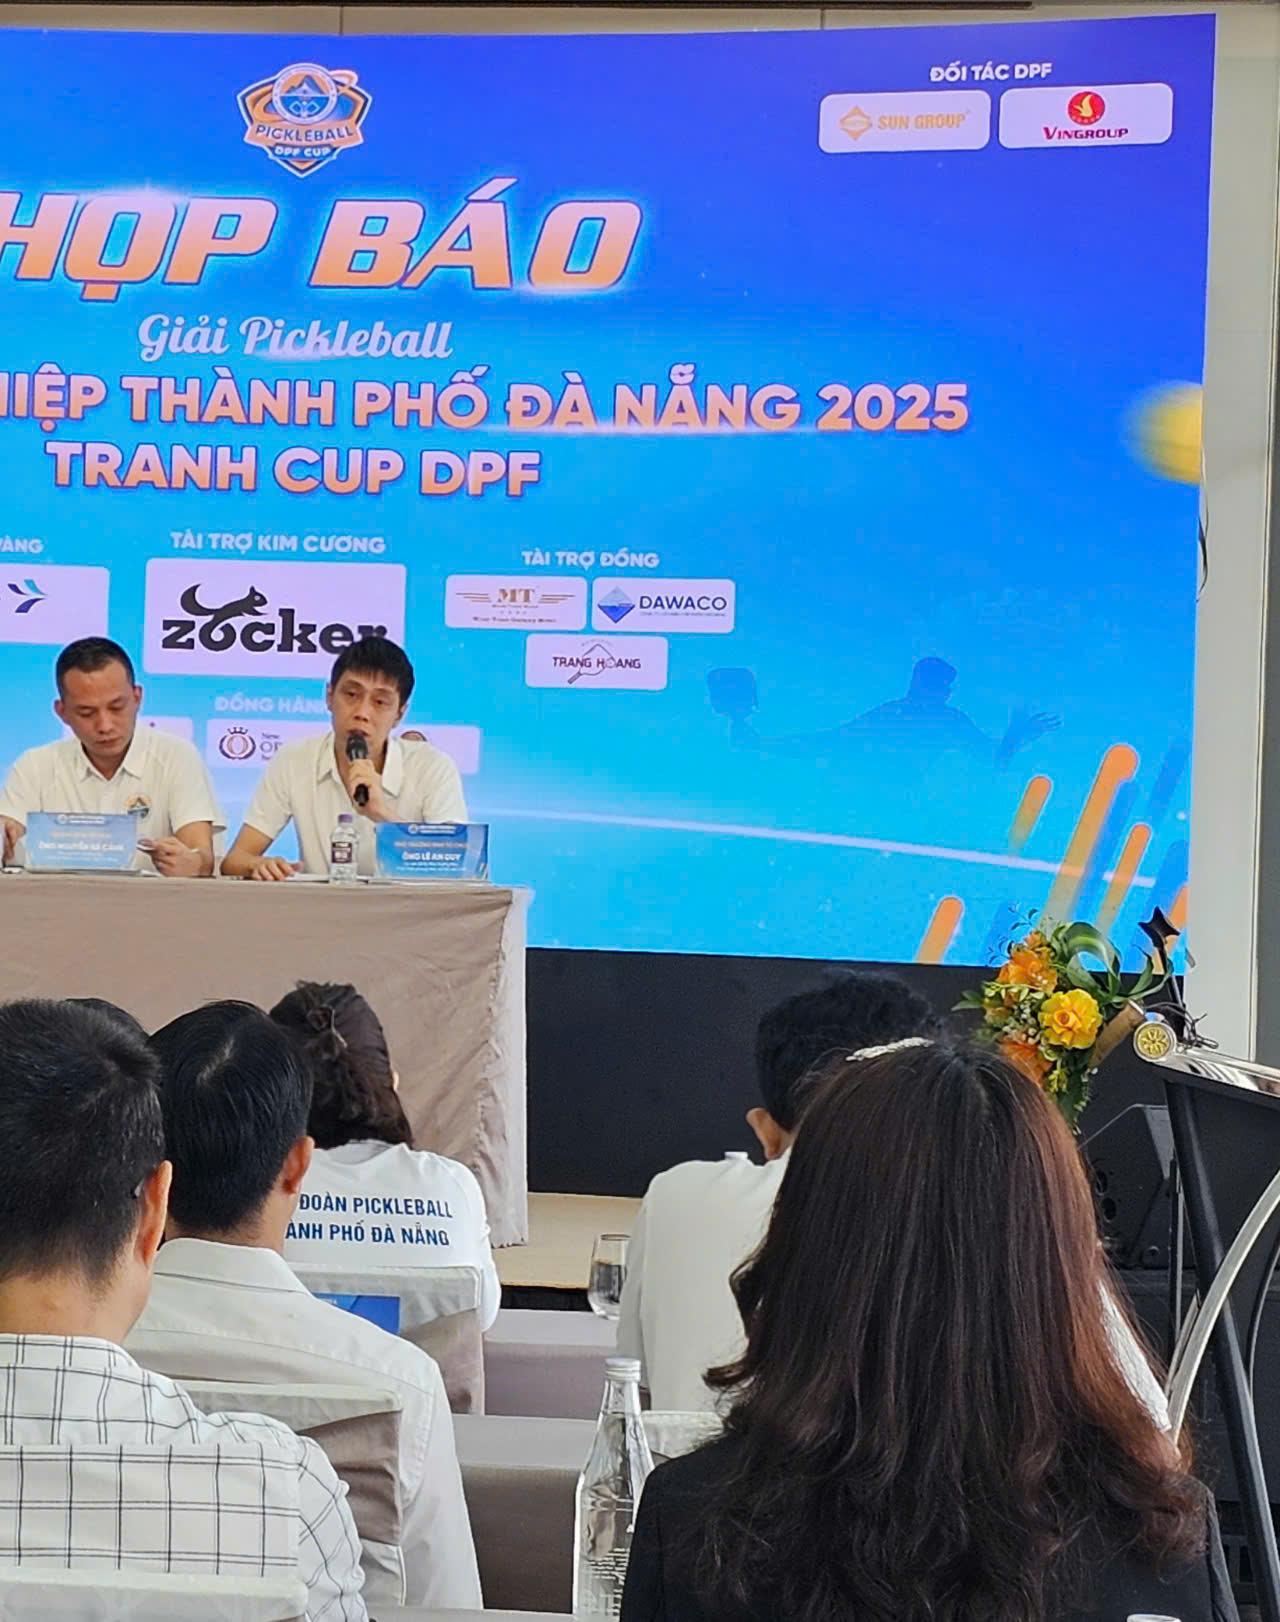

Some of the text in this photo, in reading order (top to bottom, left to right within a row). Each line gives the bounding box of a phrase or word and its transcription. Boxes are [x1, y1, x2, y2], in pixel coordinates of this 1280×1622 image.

[930, 60, 1053, 82] ĐỐI TÁC DPF
[256, 124, 354, 142] PICKLEBALL
[878, 113, 966, 130] SUN GROUP
[304, 146, 332, 156] CUP
[308, 177, 642, 290] BÁO
[138, 313, 454, 363] Giải Pickleball
[121, 365, 334, 427] THÀNH
[354, 363, 490, 429] PHỐ
[505, 369, 596, 430] ĐÀ
[614, 362, 801, 432] NẴNG
[815, 382, 969, 431] 2025
[45, 440, 542, 497] TRANH CUP DPF
[170, 528, 385, 555] TÀI TRỢ KIM CƯƠNG
[521, 547, 551, 566] TÀI
[555, 550, 596, 571] TRỢ
[497, 588, 535, 603] MT
[639, 595, 728, 611] DAWACO
[552, 656, 592, 668] TRANG
[278, 695, 327, 714] HÀN
[300, 1191, 453, 1218] ĐOÀN PICKLEBALL
[285, 1219, 322, 1239] ÀNH
[330, 1219, 364, 1242] PHỐ
[371, 1223, 395, 1243] ĐÀ
